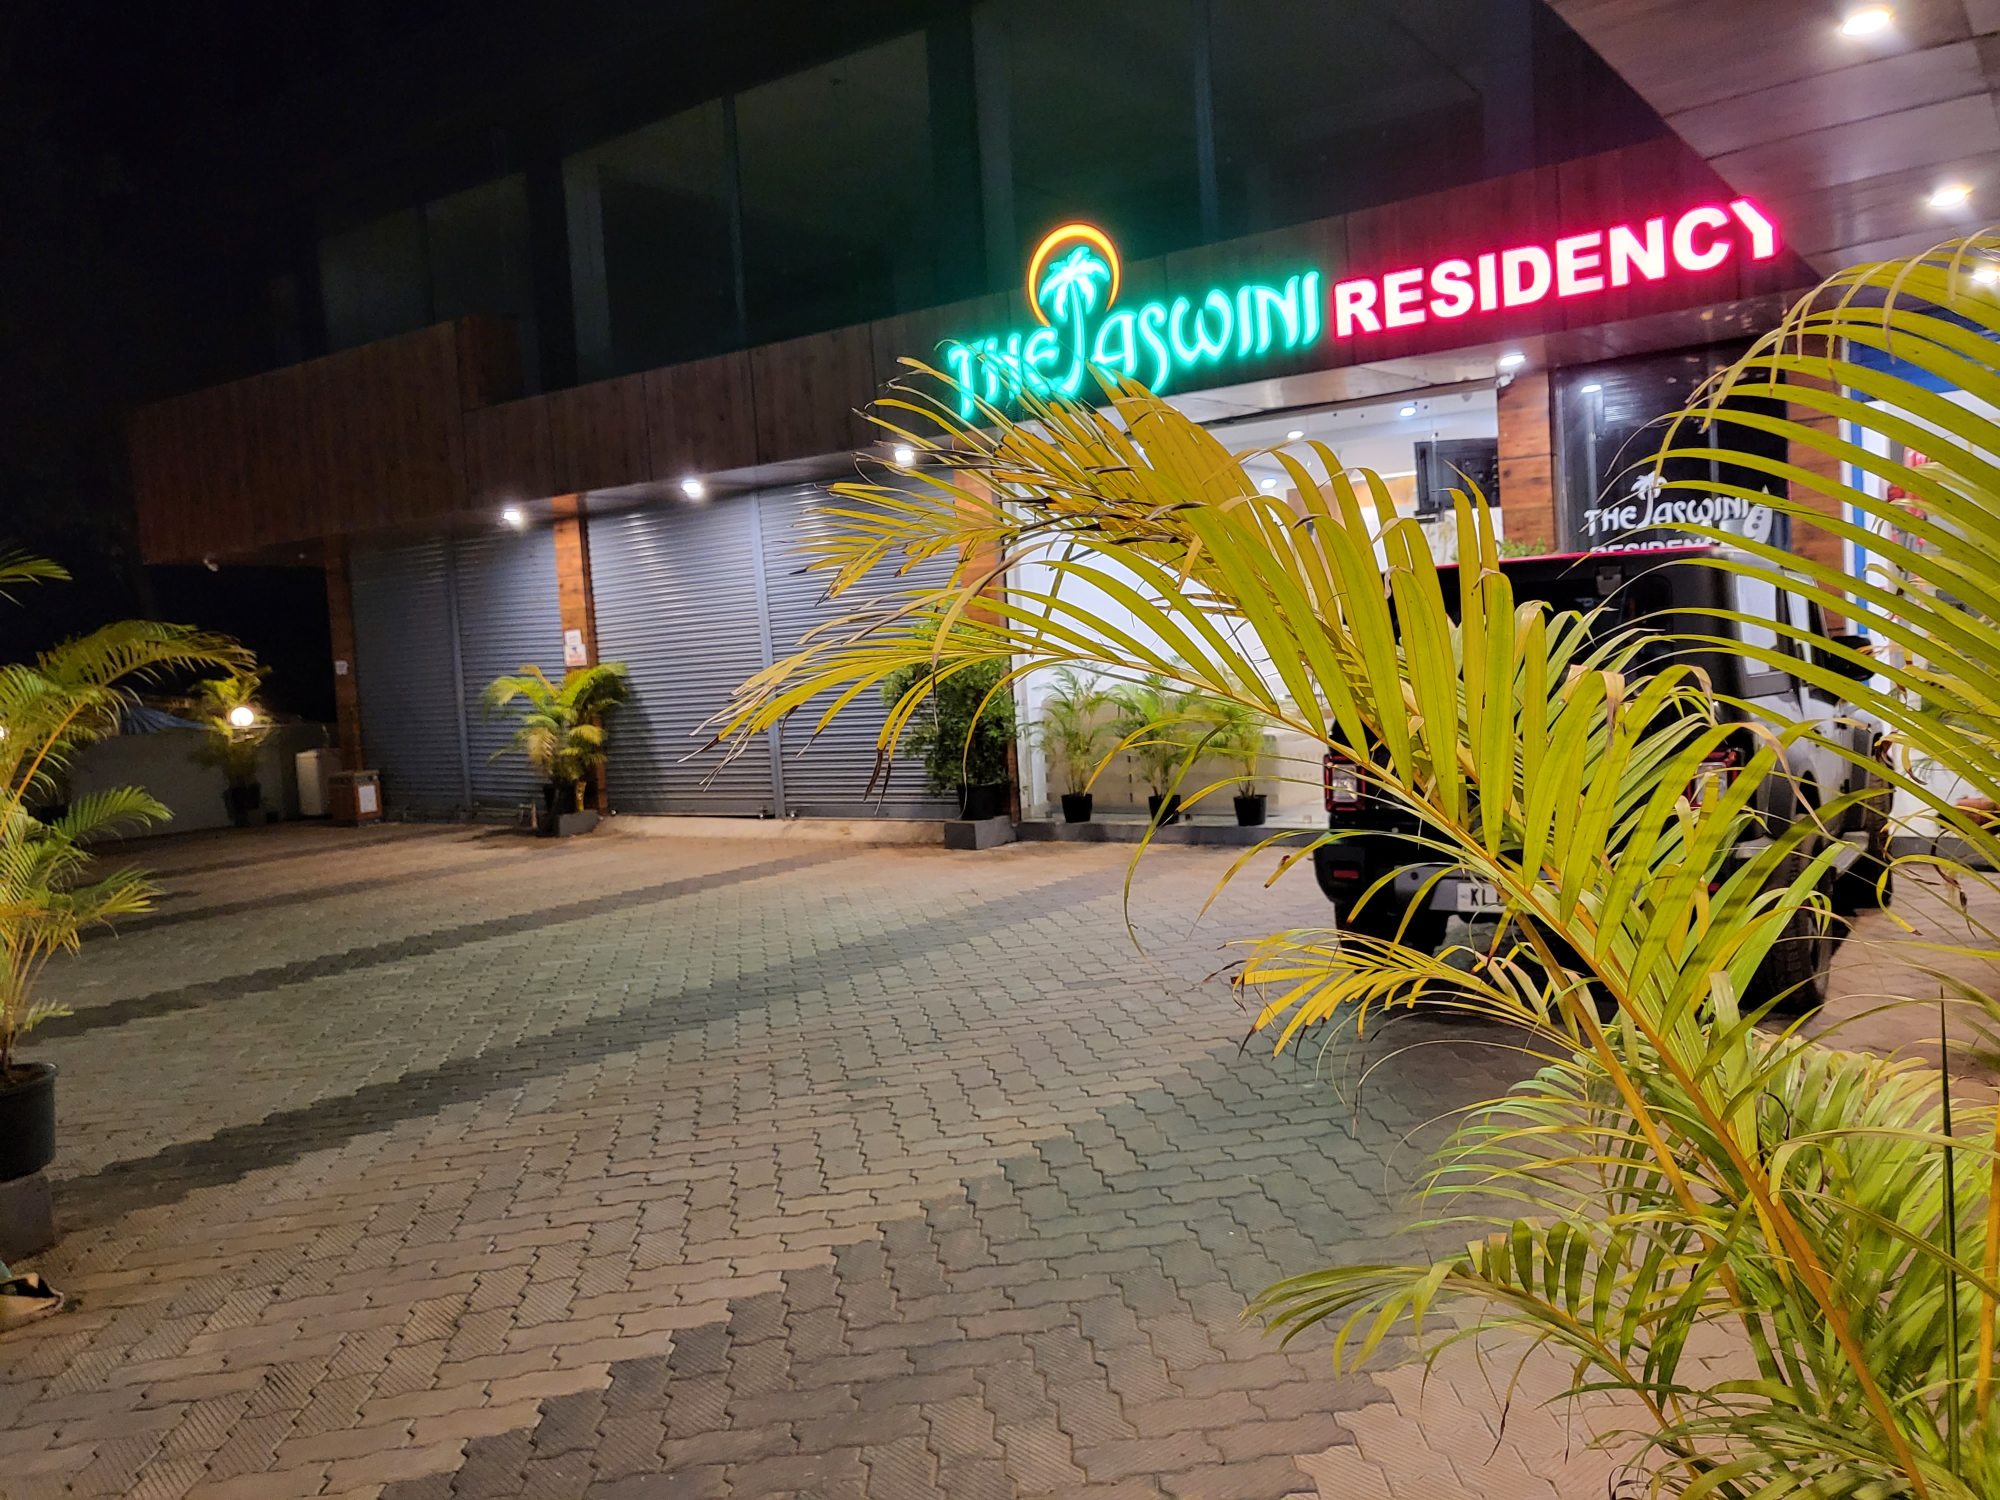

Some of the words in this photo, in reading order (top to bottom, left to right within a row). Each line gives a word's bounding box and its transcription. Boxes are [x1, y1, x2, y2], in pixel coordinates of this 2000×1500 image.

[947, 327, 1060, 420] THE
[1040, 246, 1321, 396] JASWINI
[1333, 200, 1775, 338] RESIDENCY
[1584, 507, 1637, 537] THE
[1632, 471, 1751, 532] JASWINI
